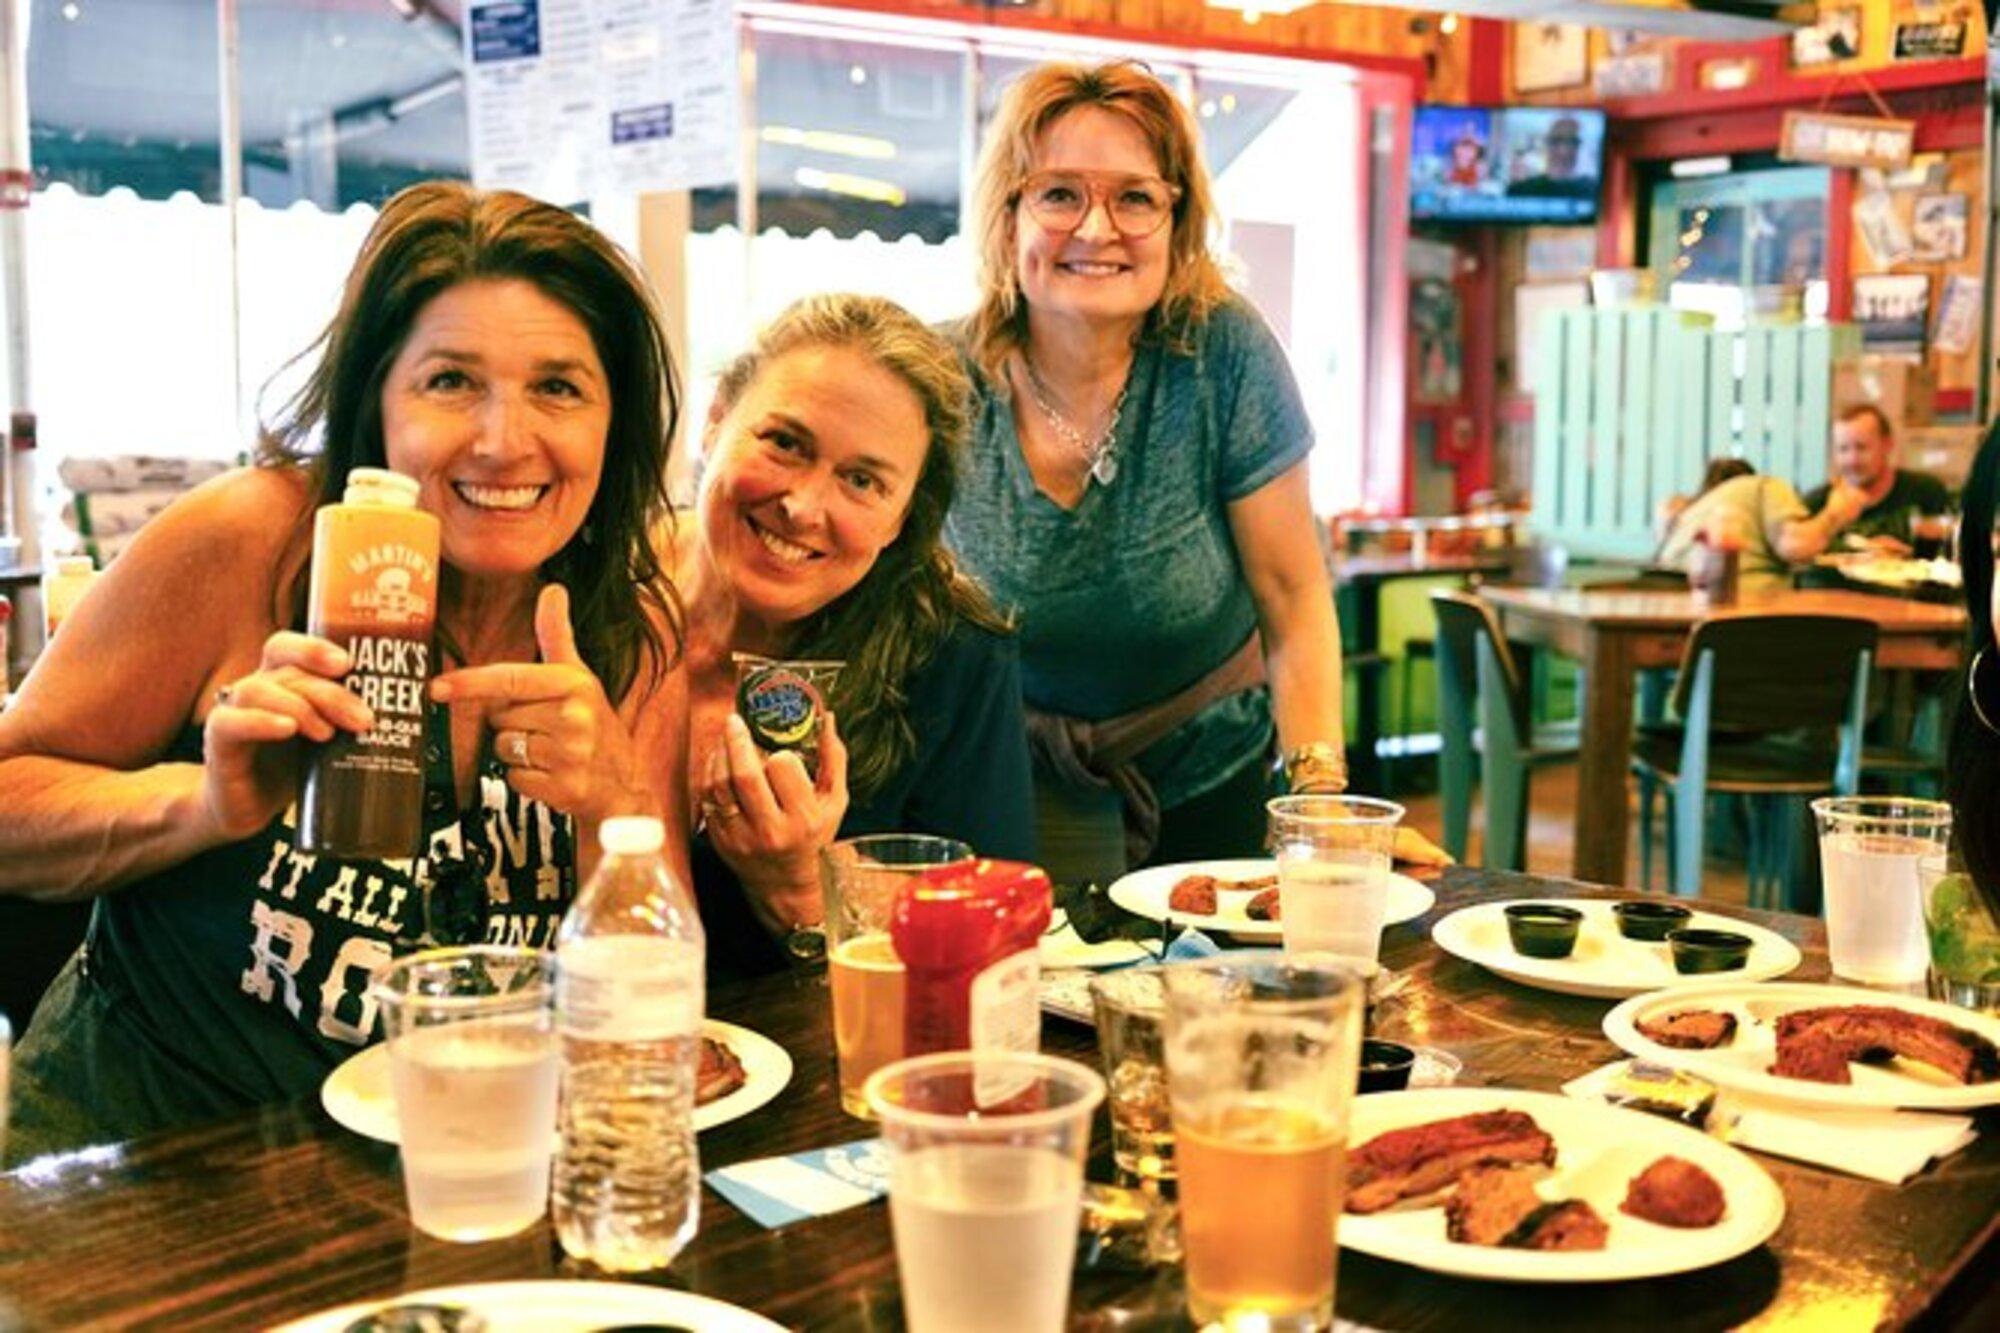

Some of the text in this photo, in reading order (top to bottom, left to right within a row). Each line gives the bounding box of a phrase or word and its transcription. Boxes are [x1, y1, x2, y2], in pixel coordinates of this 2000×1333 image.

[346, 636, 428, 678] JACK'S
[344, 675, 424, 715] CREEK
[258, 839, 408, 935] IT ALL
